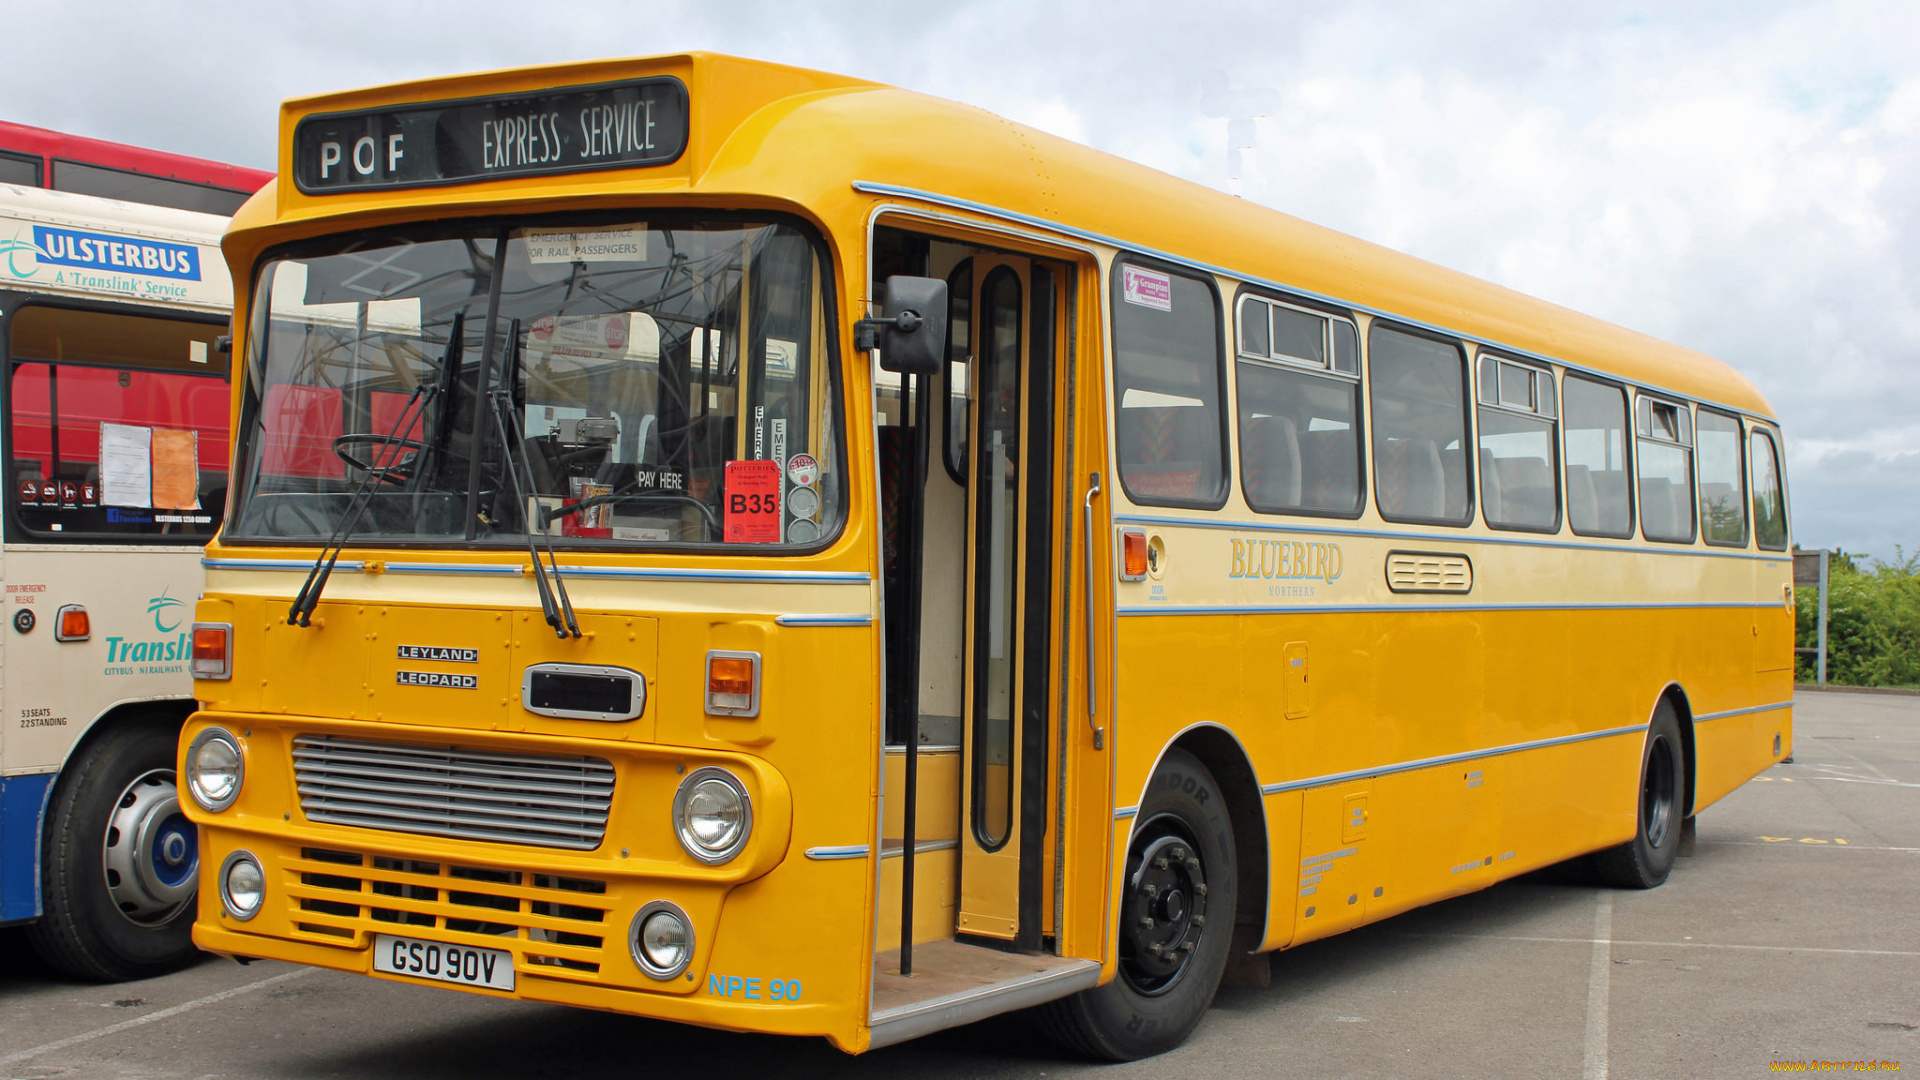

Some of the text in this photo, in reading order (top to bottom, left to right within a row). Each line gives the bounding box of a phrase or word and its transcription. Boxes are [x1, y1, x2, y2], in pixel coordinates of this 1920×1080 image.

[483, 112, 561, 169] EXPRESS
[580, 100, 656, 158] SERVICE
[593, 228, 634, 239] SERVICE
[45, 233, 191, 274] ULSTERBUS
[548, 247, 570, 257] RAIL
[574, 243, 638, 255] PASSENGERS
[55, 271, 64, 283] A
[145, 281, 187, 297] Service
[638, 471, 682, 489] PAY HERE
[731, 494, 776, 514] B35
[1229, 538, 1343, 584] BLUEBIRD
[19, 584, 47, 593] EMERGENCY
[1269, 586, 1315, 597] NORTHERN
[15, 595, 35, 604] RELEASE
[105, 632, 193, 663] Transli
[401, 646, 474, 661] LEYLAND
[104, 667, 134, 676] CITYBUS
[149, 665, 183, 674] RAILWAYS
[400, 672, 473, 687] LEOPARD
[30, 708, 51, 717] SEATS
[30, 717, 67, 728] STANDING
[709, 973, 802, 1001] NPE 90
